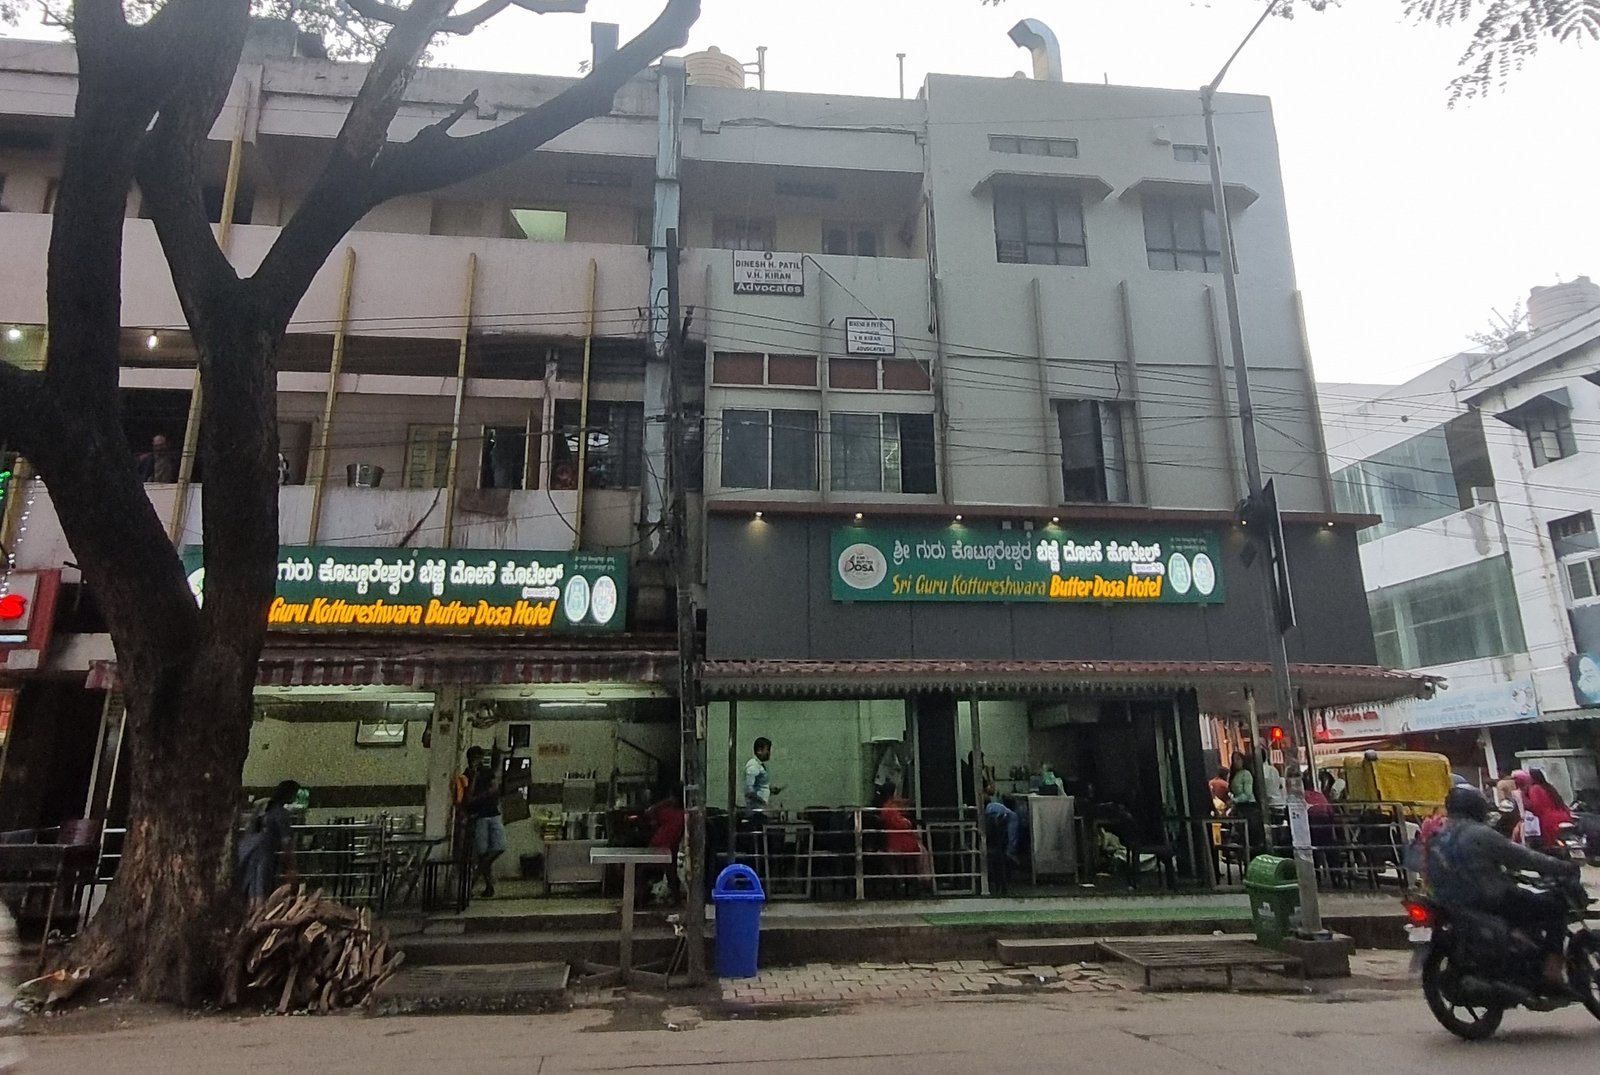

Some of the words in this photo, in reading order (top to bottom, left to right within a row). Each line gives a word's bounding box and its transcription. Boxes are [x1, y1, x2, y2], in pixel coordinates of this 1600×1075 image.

[735, 260, 766, 268] DINESH
[779, 261, 801, 269] PATIL
[764, 272, 791, 280] KIRAN
[736, 283, 801, 293] Advocates
[893, 539, 911, 565] ಶ್ರೀ
[916, 539, 946, 560] ಗುರು
[1036, 539, 1061, 572] ಬೆಣ್ಣೆ
[1063, 539, 1103, 562] ದೋಸೆ
[277, 556, 314, 581] ಗುರು
[419, 558, 447, 597] ಬೆಣ್ಣೆ
[450, 559, 497, 585] ದೋಸೆ
[892, 574, 913, 595] Sri
[915, 574, 948, 596] Guru
[950, 574, 1047, 596] Kottureshwara
[1049, 574, 1094, 598] Butter
[1093, 575, 1126, 598] Dosa
[1125, 575, 1163, 597] Hotel
[268, 596, 311, 625] Guru
[308, 597, 423, 625] Kottureshwara
[424, 598, 476, 626] Butter
[474, 599, 512, 626] Dosa
[512, 600, 557, 627] Hotel
